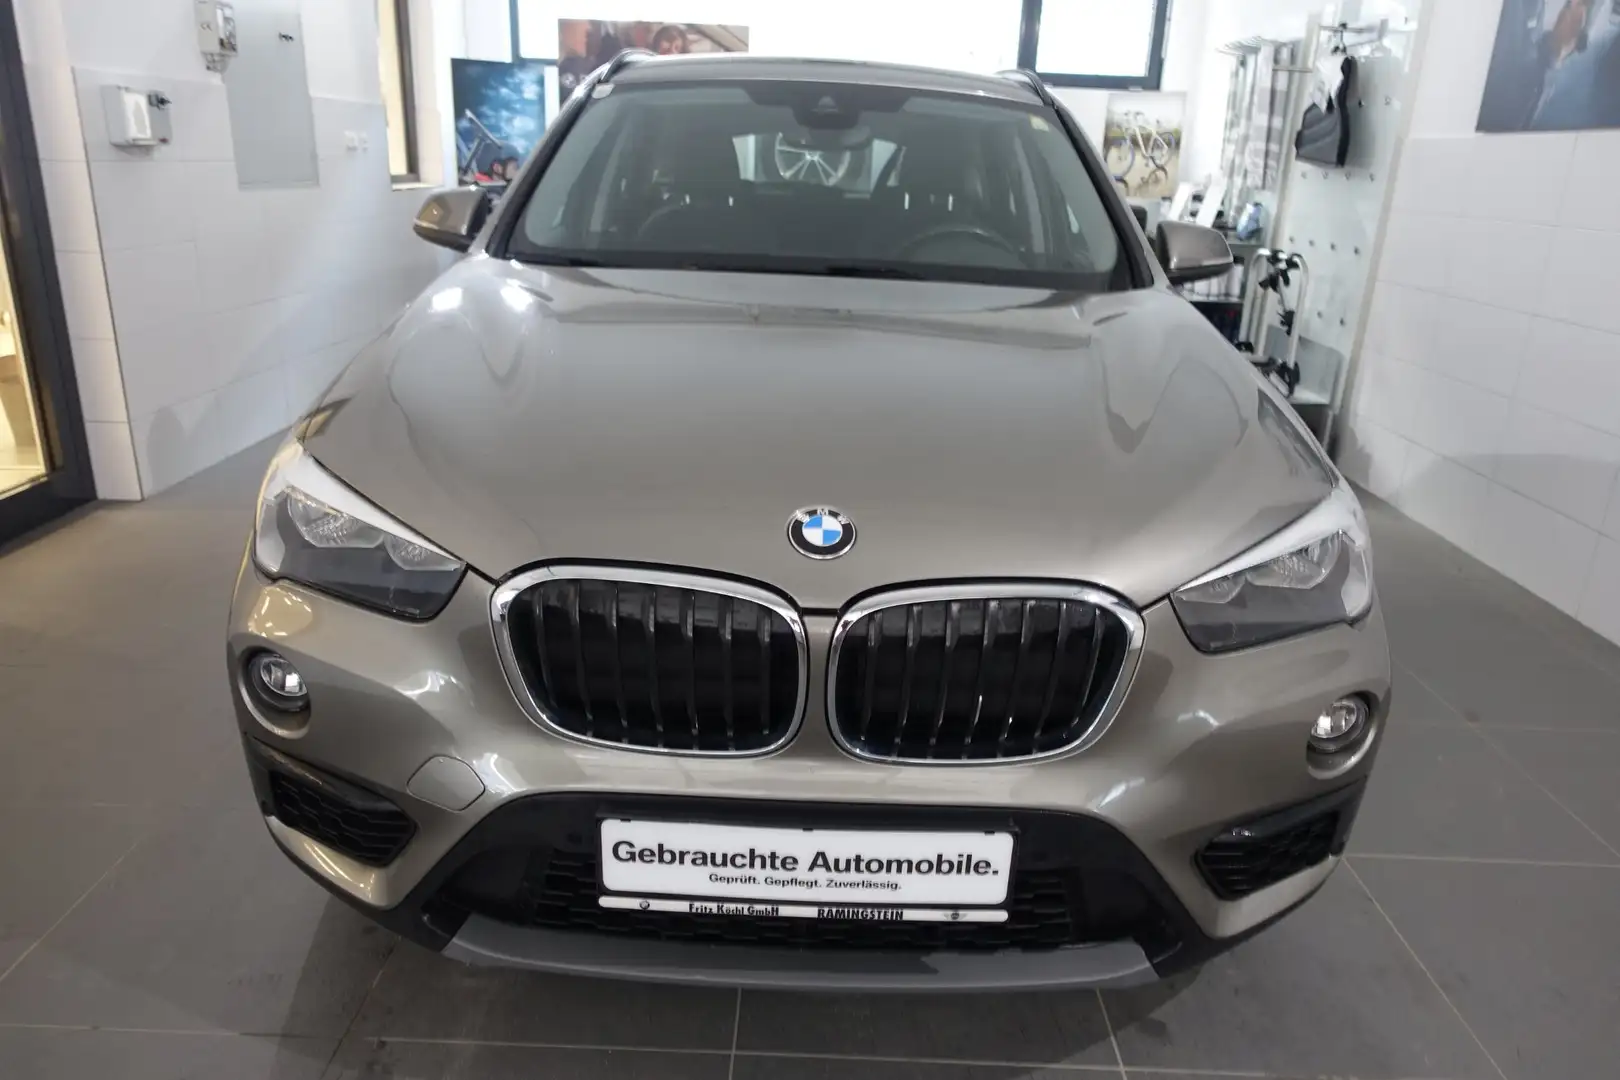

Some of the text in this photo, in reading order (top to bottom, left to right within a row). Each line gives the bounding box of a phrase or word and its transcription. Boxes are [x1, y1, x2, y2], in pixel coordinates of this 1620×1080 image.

[612, 840, 999, 876] Gebrauchte Automobile.
[709, 873, 902, 891] Geprüft. Gepflegt. Zuverlässig.
[688, 903, 713, 915] Fritz
[747, 905, 780, 917] GmbH
[817, 907, 904, 921] RAMINGSTEIN
